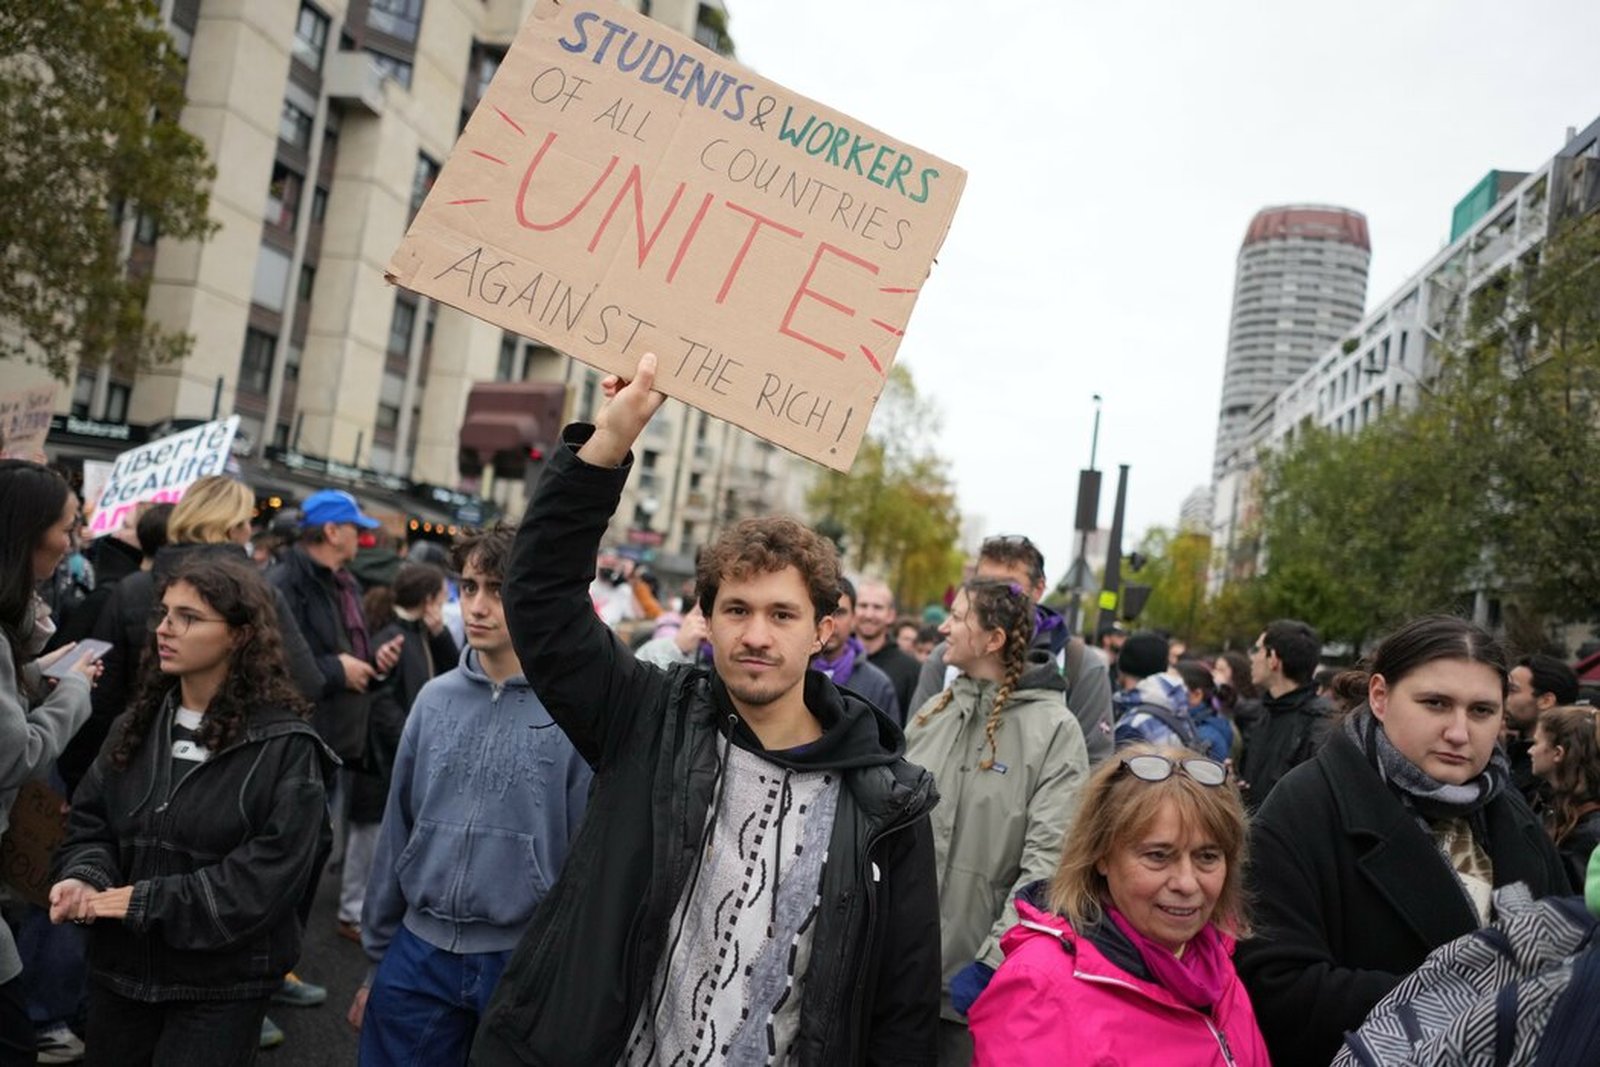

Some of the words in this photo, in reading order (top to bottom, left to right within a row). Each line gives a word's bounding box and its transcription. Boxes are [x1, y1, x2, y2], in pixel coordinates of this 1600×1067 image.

[531, 66, 592, 112] OF
[593, 97, 651, 143] ALL
[700, 138, 912, 251] COUNTRIES
[557, 11, 755, 122] STUDENTS
[749, 95, 776, 131] &
[777, 105, 940, 204] WORKERS
[433, 247, 657, 355] AGAINST
[674, 336, 745, 397] THE
[514, 131, 881, 361] UNITE
